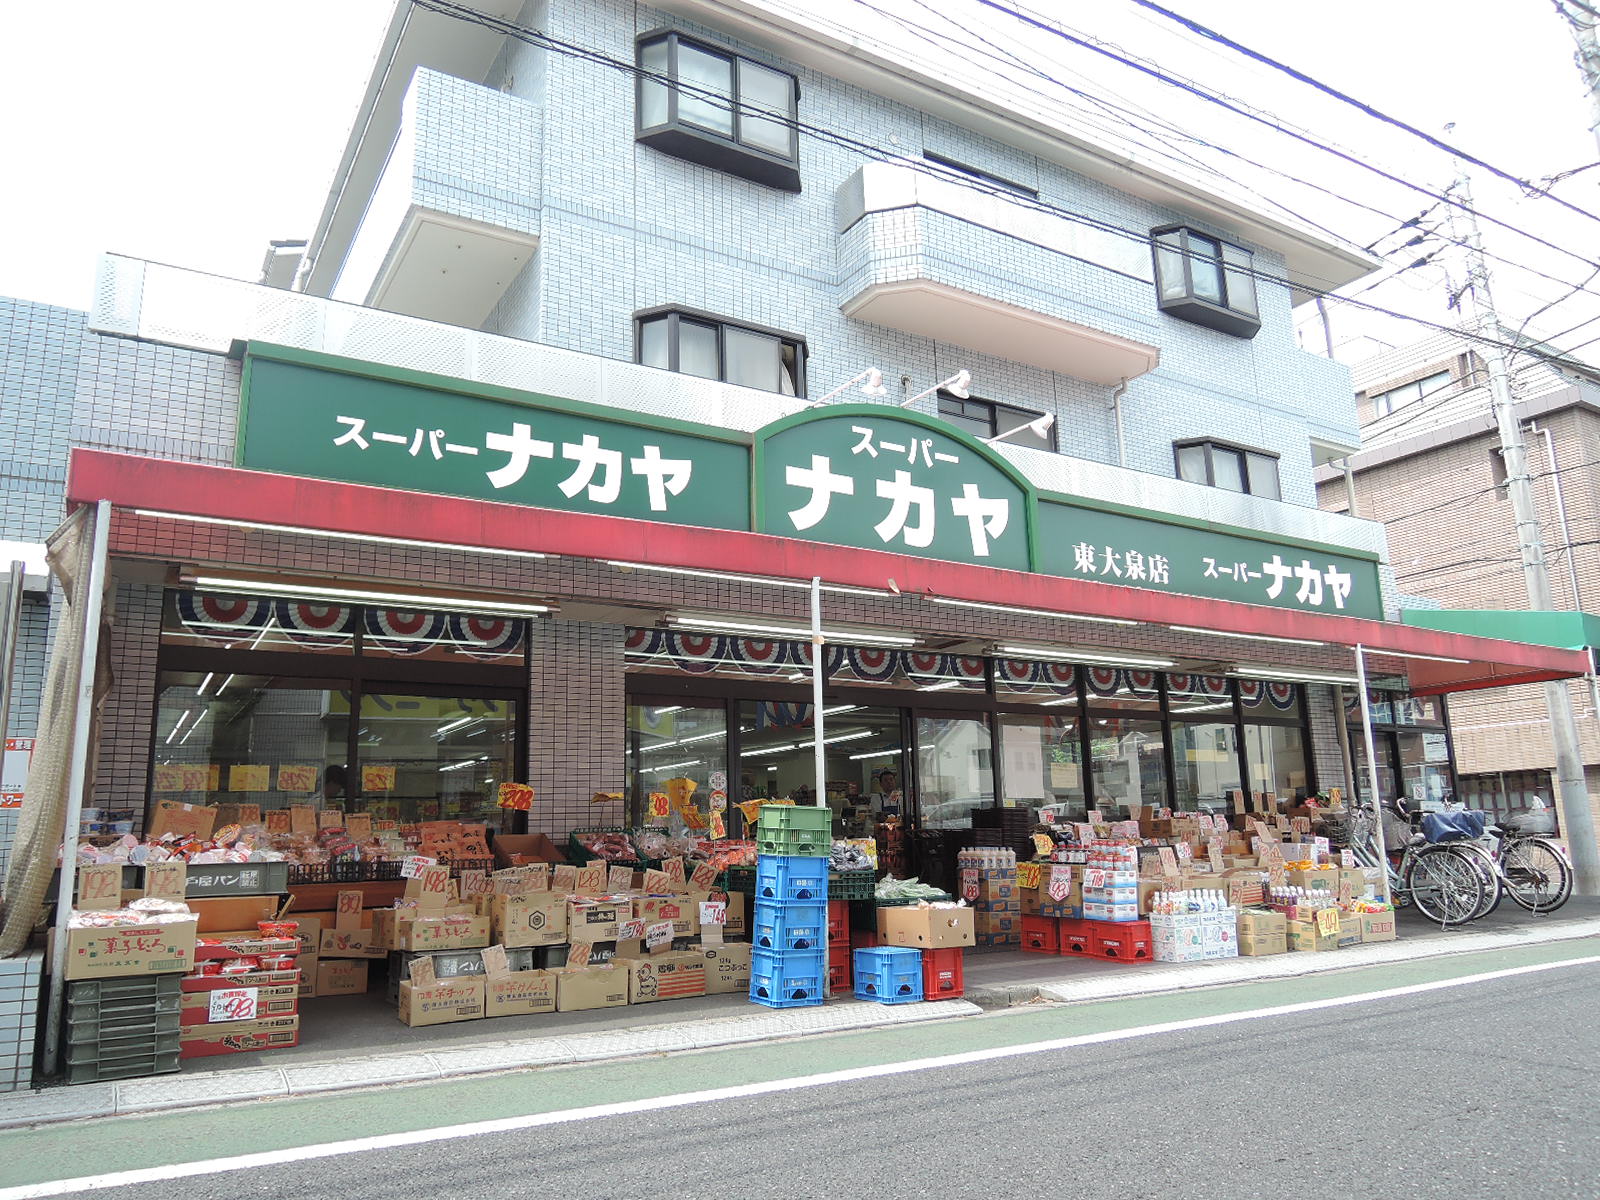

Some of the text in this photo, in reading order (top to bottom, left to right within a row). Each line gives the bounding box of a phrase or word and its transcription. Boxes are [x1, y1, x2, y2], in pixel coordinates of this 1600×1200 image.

[851, 425, 959, 468] スーパー
[785, 454, 1009, 557] ナカヤ
[1072, 542, 1169, 585] 東大泉店
